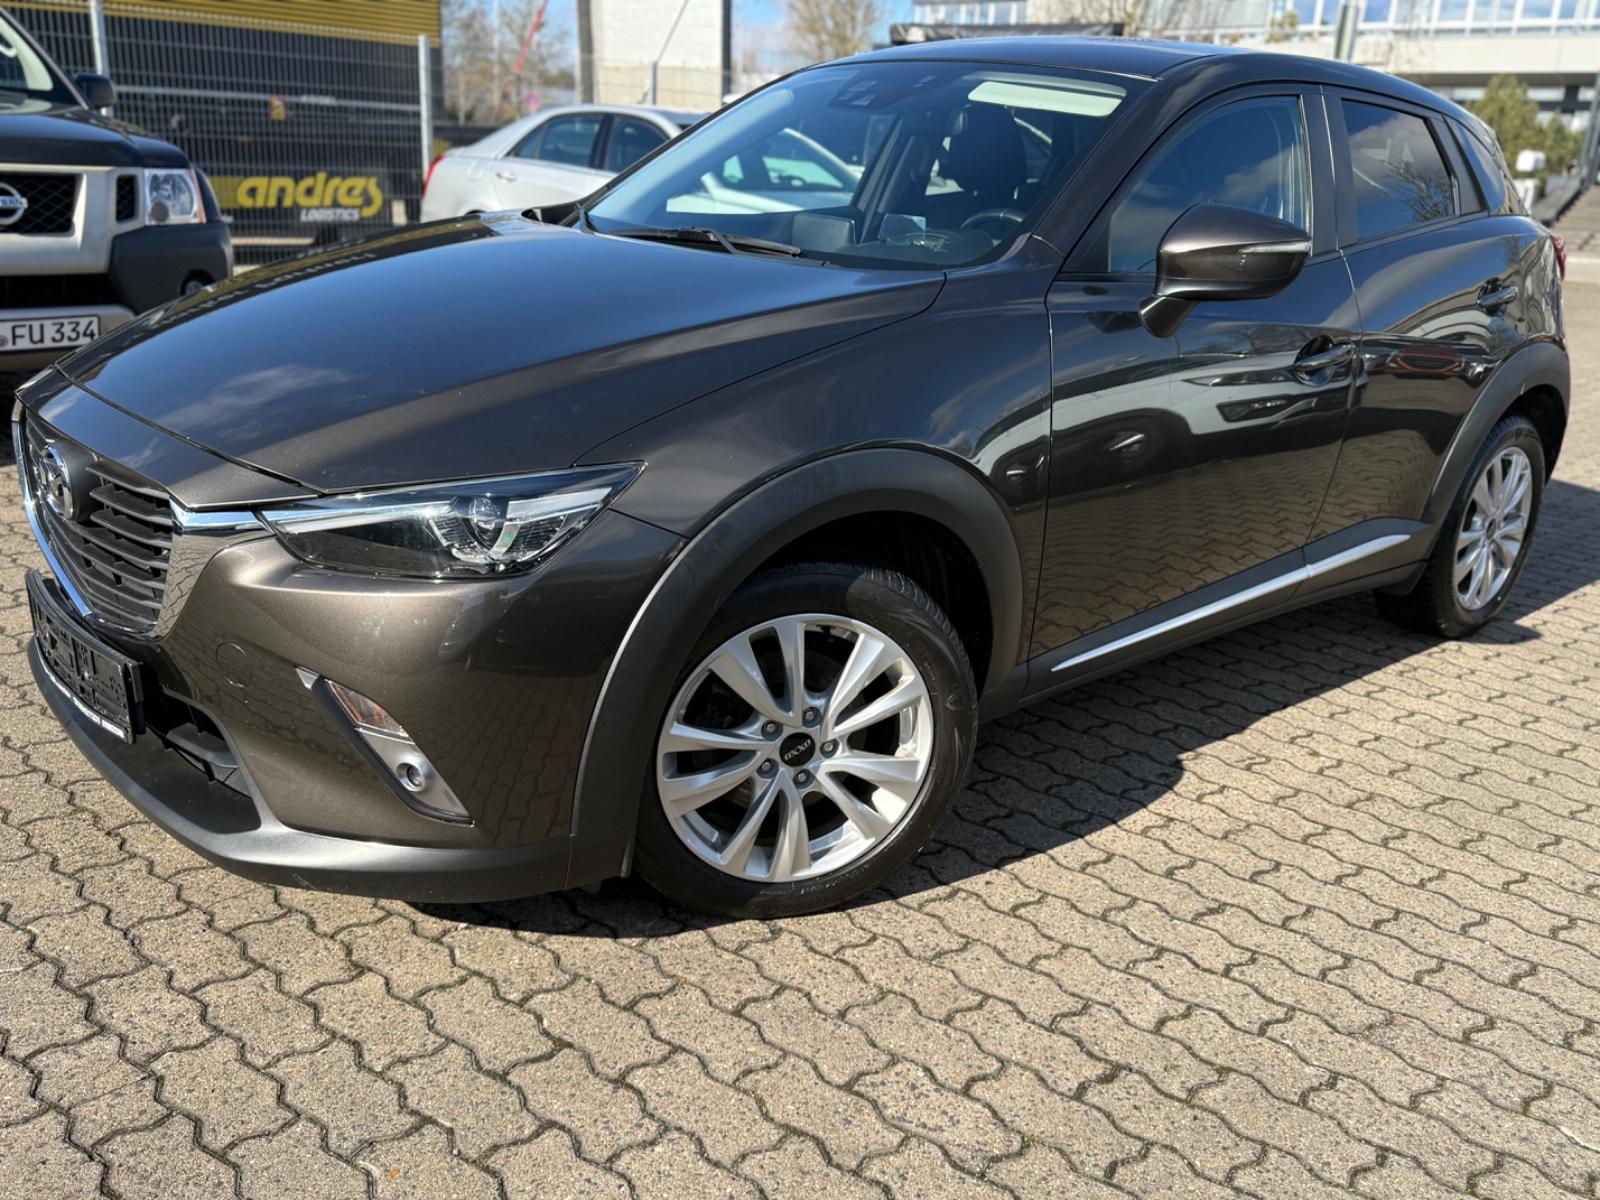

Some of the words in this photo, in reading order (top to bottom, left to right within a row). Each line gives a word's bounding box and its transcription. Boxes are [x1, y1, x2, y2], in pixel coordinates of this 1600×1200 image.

[237, 171, 383, 218] andres
[11, 323, 45, 346] FU
[51, 320, 96, 343] 334
